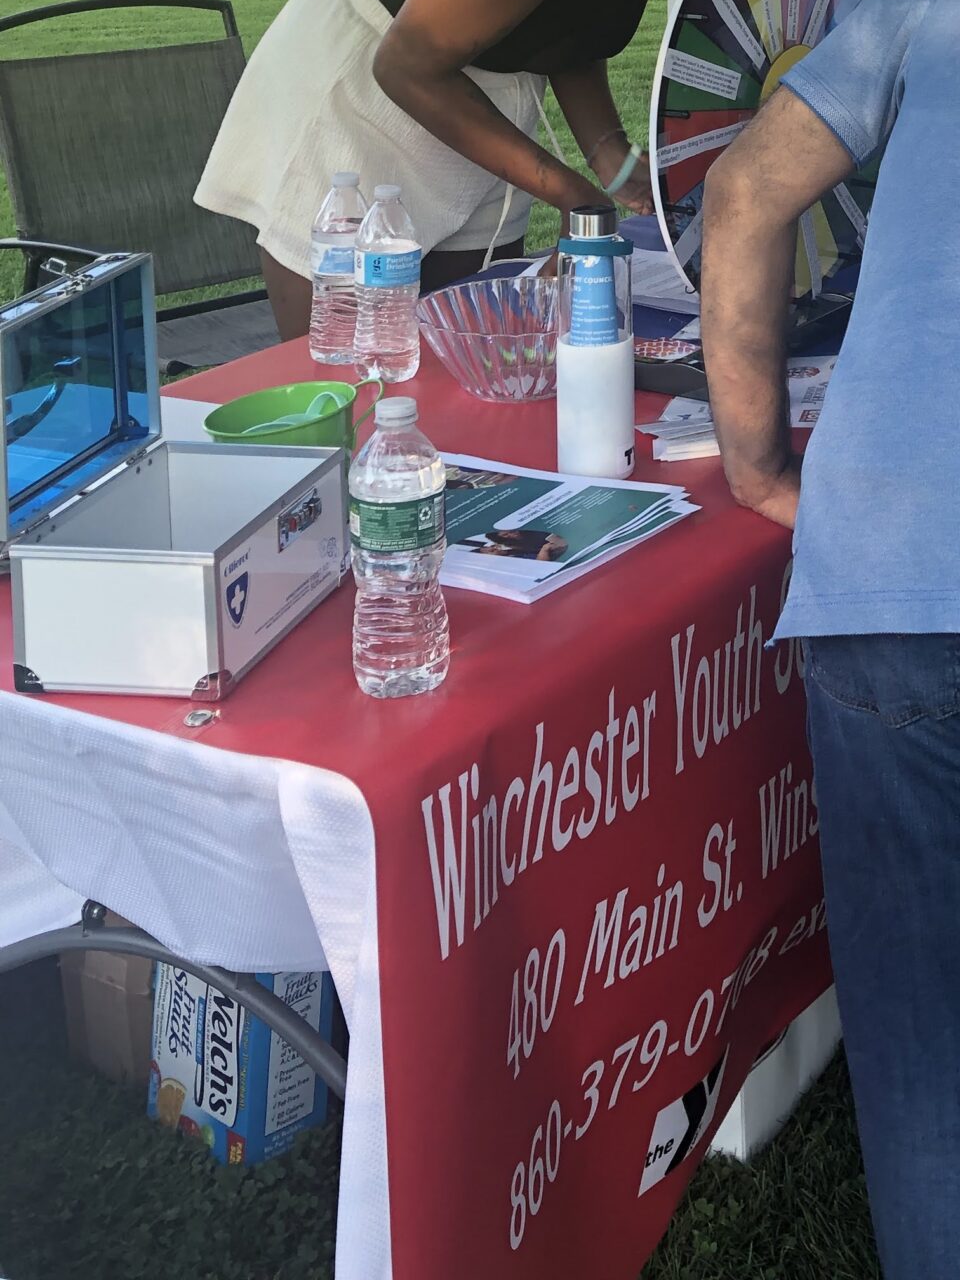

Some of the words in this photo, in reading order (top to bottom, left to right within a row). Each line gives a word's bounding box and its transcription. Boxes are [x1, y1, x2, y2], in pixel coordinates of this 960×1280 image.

[421, 686, 657, 961] Winchester
[671, 584, 761, 776] Youth
[285, 972, 315, 997] Fruit
[507, 927, 567, 1080] 480
[574, 863, 684, 1005] Main
[698, 818, 744, 929] St.
[168, 967, 188, 1059] Snacks
[180, 989, 196, 1058] Fruit
[644, 1137, 675, 1168] the
